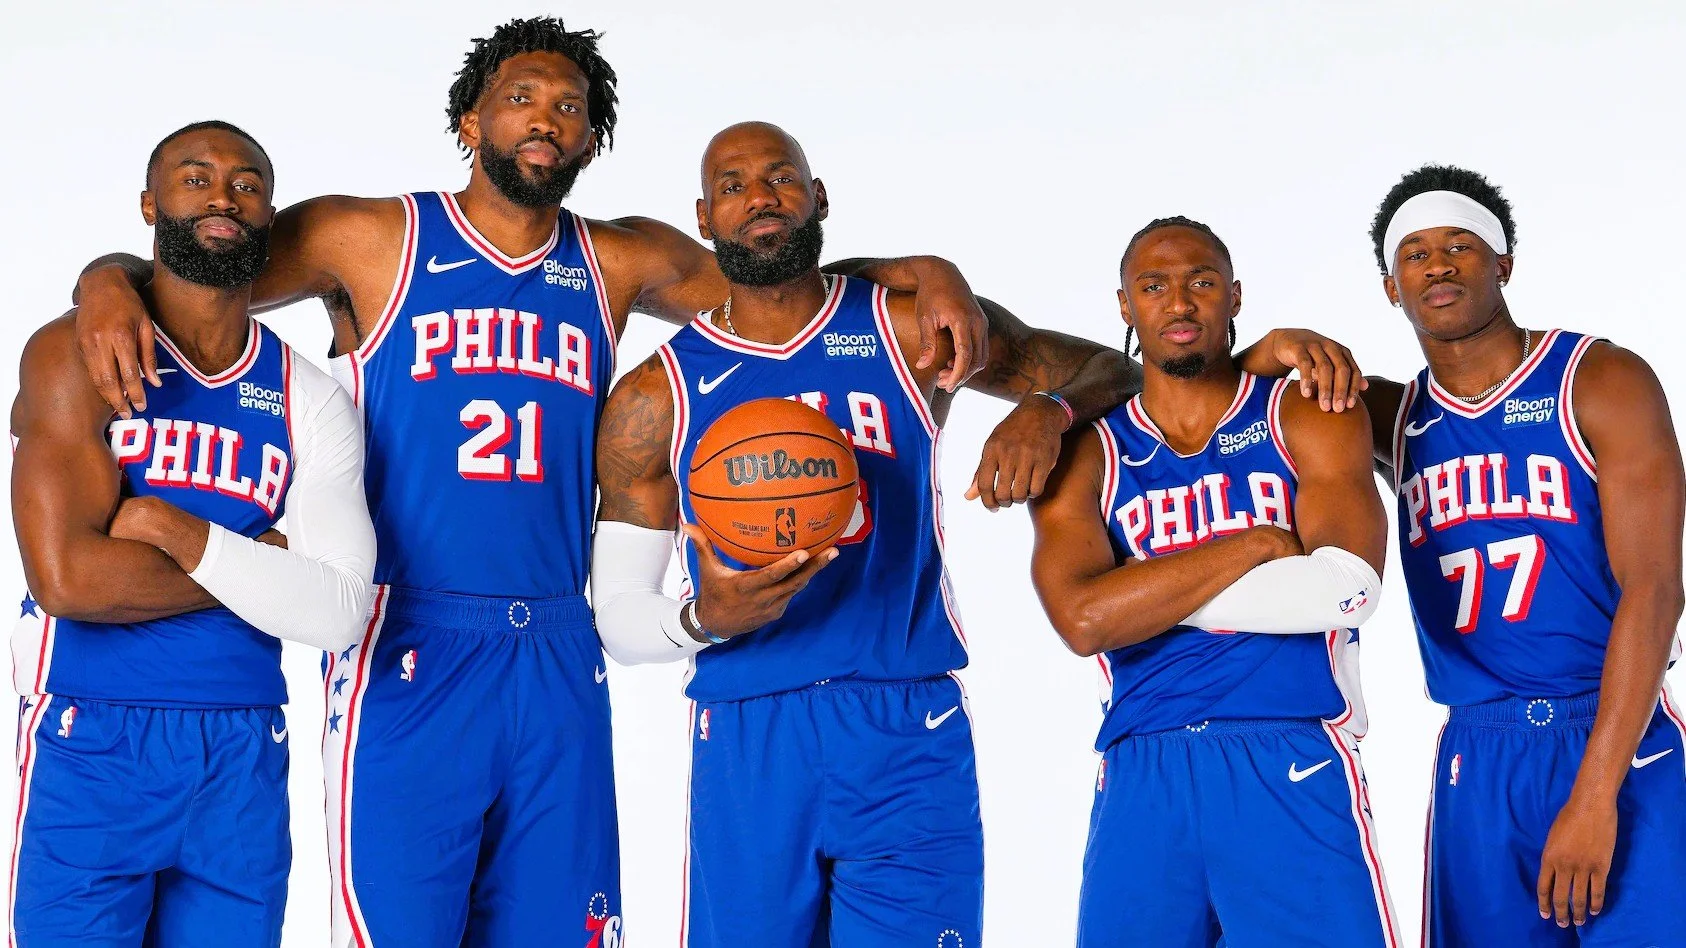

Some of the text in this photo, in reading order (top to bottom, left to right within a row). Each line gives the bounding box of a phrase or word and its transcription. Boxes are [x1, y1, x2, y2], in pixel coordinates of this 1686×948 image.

[544, 260, 587, 278] Bloom
[545, 274, 587, 291] energy
[823, 333, 876, 345] Bloom
[826, 345, 877, 357] energy
[411, 308, 594, 396] PHILA
[239, 382, 284, 403] Bloom
[1504, 408, 1554, 424] energy
[1505, 397, 1554, 413] Bloom
[458, 399, 543, 482] 21
[1218, 421, 1267, 446] Bloom
[1220, 430, 1268, 454] energy
[109, 418, 291, 518] PHILA
[723, 449, 838, 486] Wilson
[1400, 453, 1578, 547] PHILA
[1115, 471, 1296, 561] PHILA
[1439, 534, 1546, 634] 77
